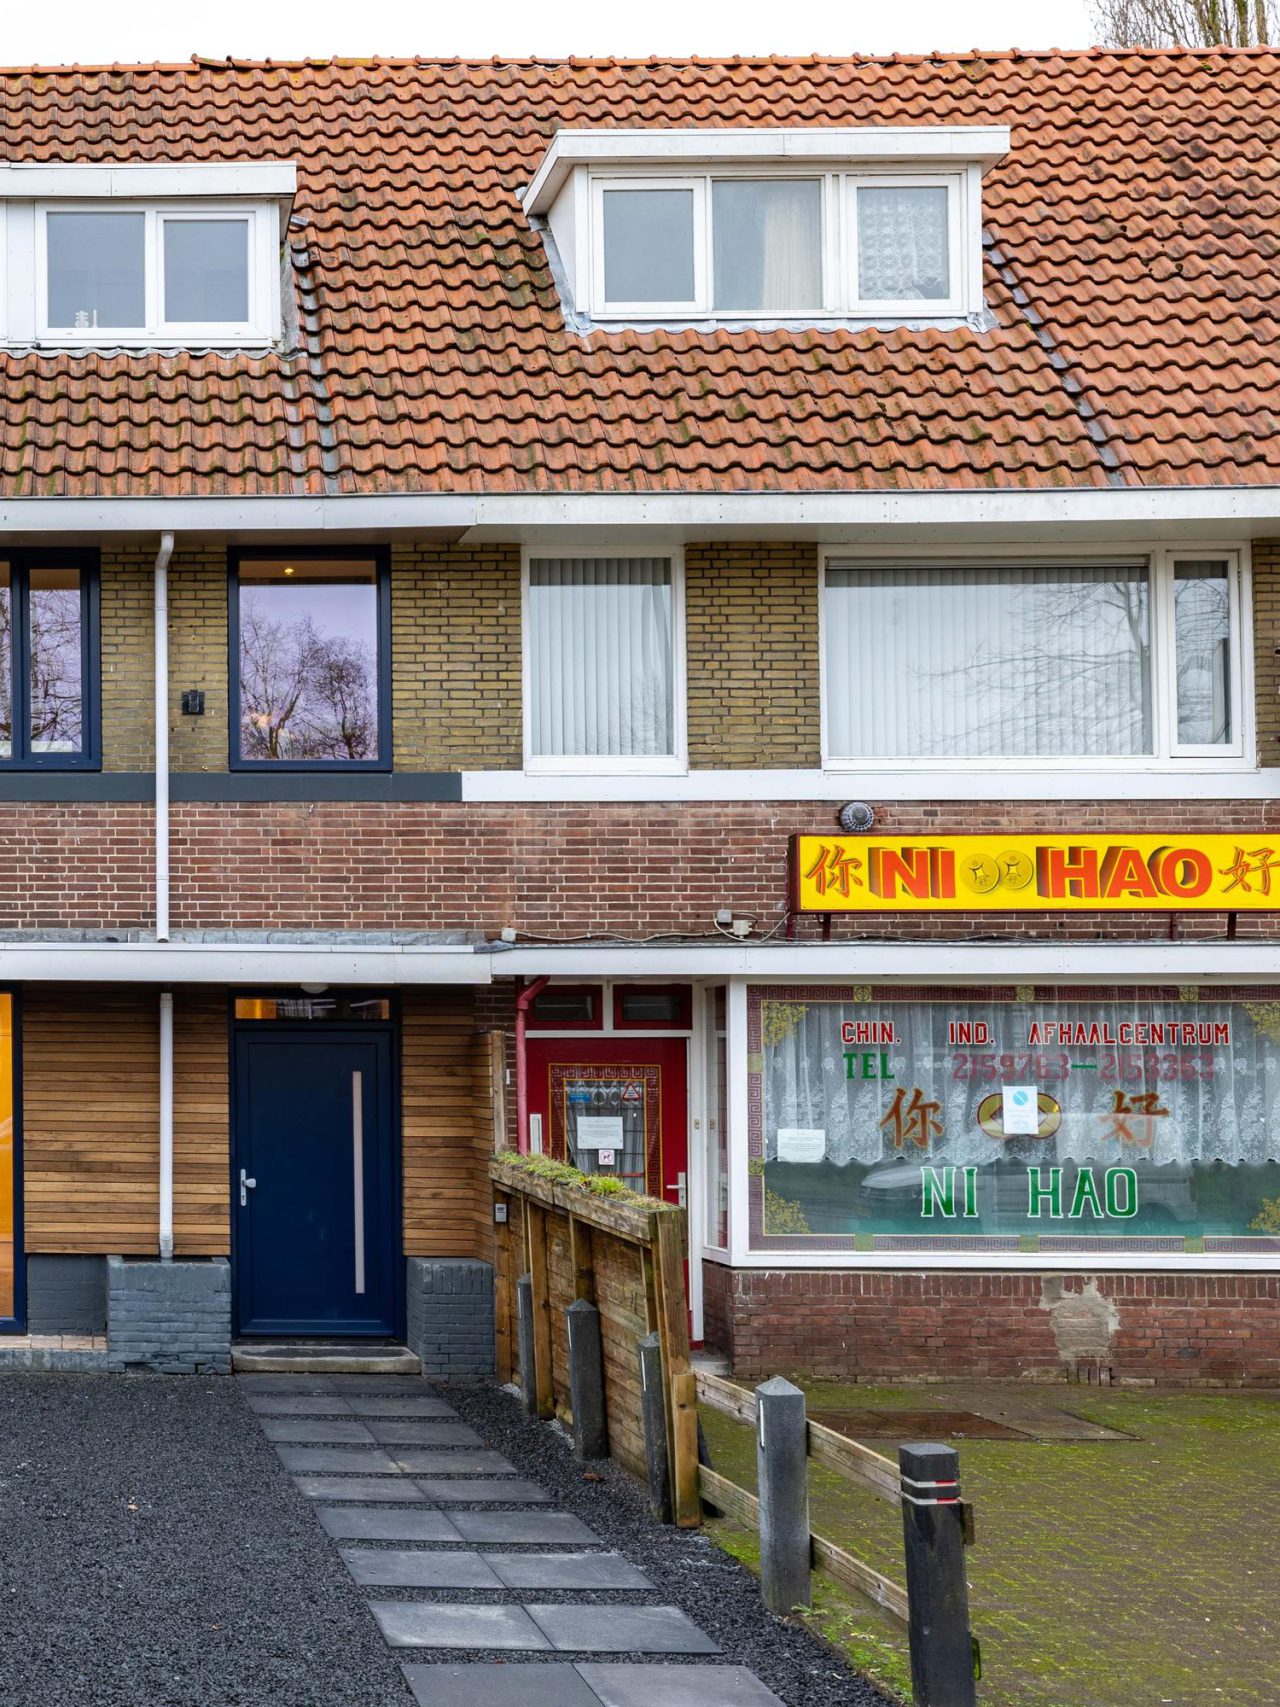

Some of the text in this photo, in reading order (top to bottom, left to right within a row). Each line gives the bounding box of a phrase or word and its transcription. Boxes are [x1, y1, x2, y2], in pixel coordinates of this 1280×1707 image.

[804, 844, 863, 898] 你
[869, 846, 1213, 899] NI HAO
[1218, 846, 1280, 897] 好
[841, 1021, 1231, 1045] CHIN. IND. AFHAALCENTRUM
[843, 1053, 895, 1079] TEL
[880, 1087, 945, 1148] 你
[1100, 1089, 1171, 1149] 好
[920, 1166, 1139, 1218] NI HAO
